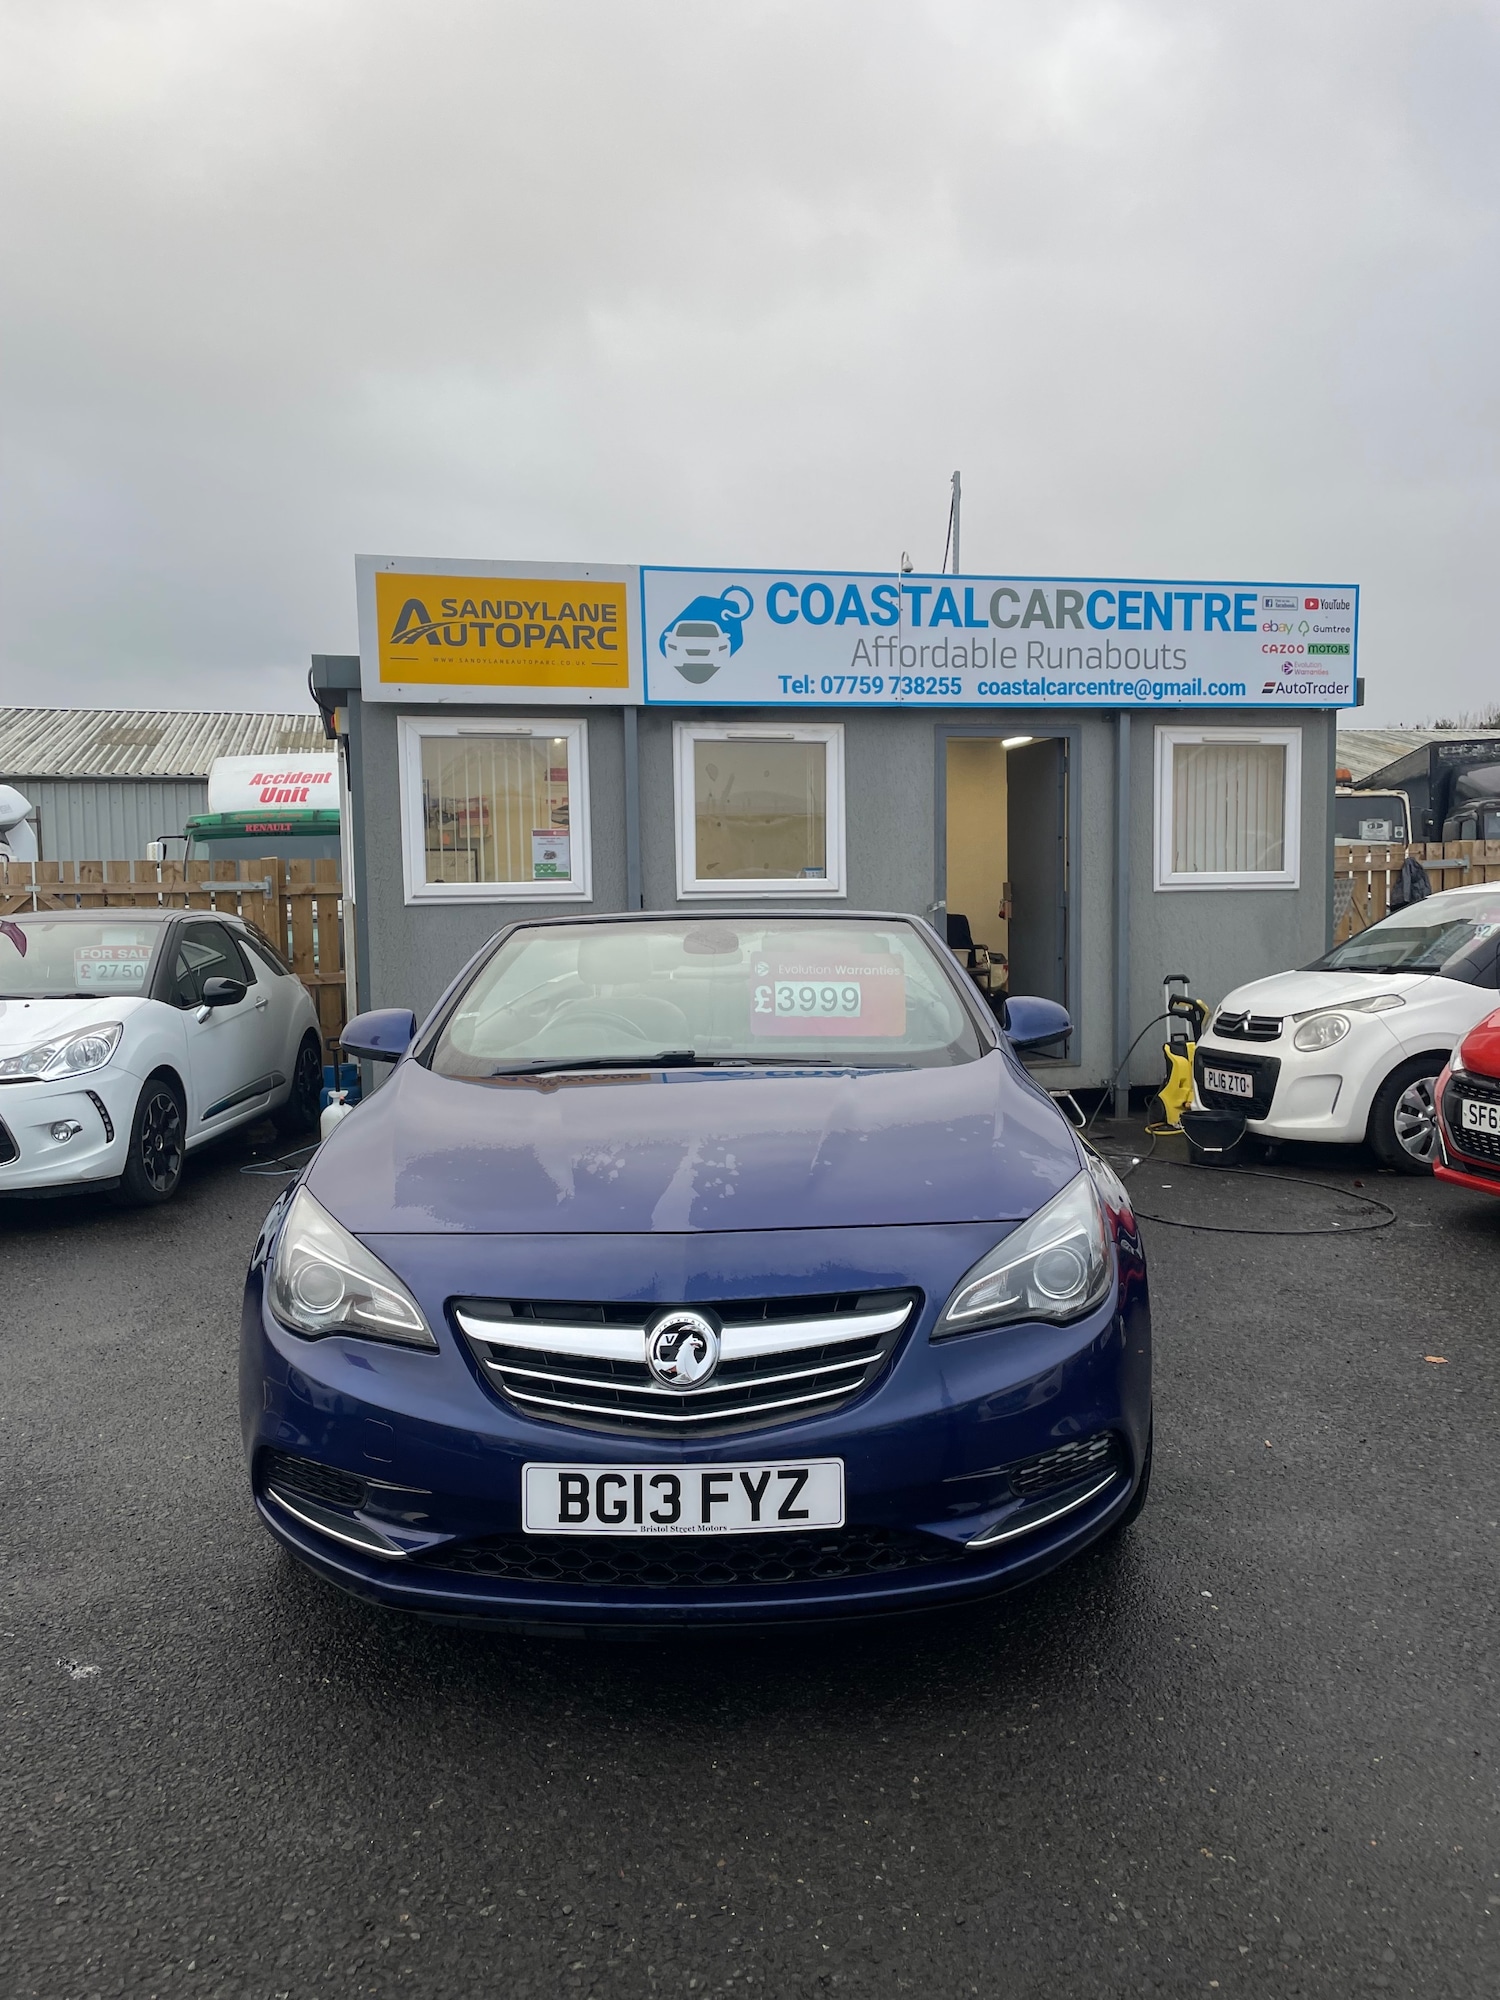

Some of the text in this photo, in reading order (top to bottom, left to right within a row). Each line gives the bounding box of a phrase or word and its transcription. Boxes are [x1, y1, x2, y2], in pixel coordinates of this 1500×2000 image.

[441, 599, 617, 623] SANDYLANE
[766, 581, 1258, 632] COASTALCARCENTRE
[1320, 598, 1350, 610] YouTube
[389, 598, 618, 650] AUTOPARC
[1262, 620, 1294, 635] ebay
[1313, 625, 1351, 633] Gumtree
[851, 636, 1187, 671] Affordable Runabouts
[778, 675, 1246, 700] Tel: 07759 738255 coastalcarcentre@gmail.com
[1275, 682, 1350, 695] AutoTrader
[248, 771, 333, 786] Accident
[259, 787, 310, 803] Unit
[245, 822, 292, 832] RENAULT
[80, 949, 113, 959] FOR
[778, 964, 901, 976] Evolution Warranties
[754, 984, 859, 1014] £3999
[1208, 1071, 1246, 1093] PL16 ZTO
[1469, 1103, 1500, 1129] SF6
[558, 1468, 809, 1525] BG13 FYZ
[640, 1524, 728, 1534] Bristol Street Motors
